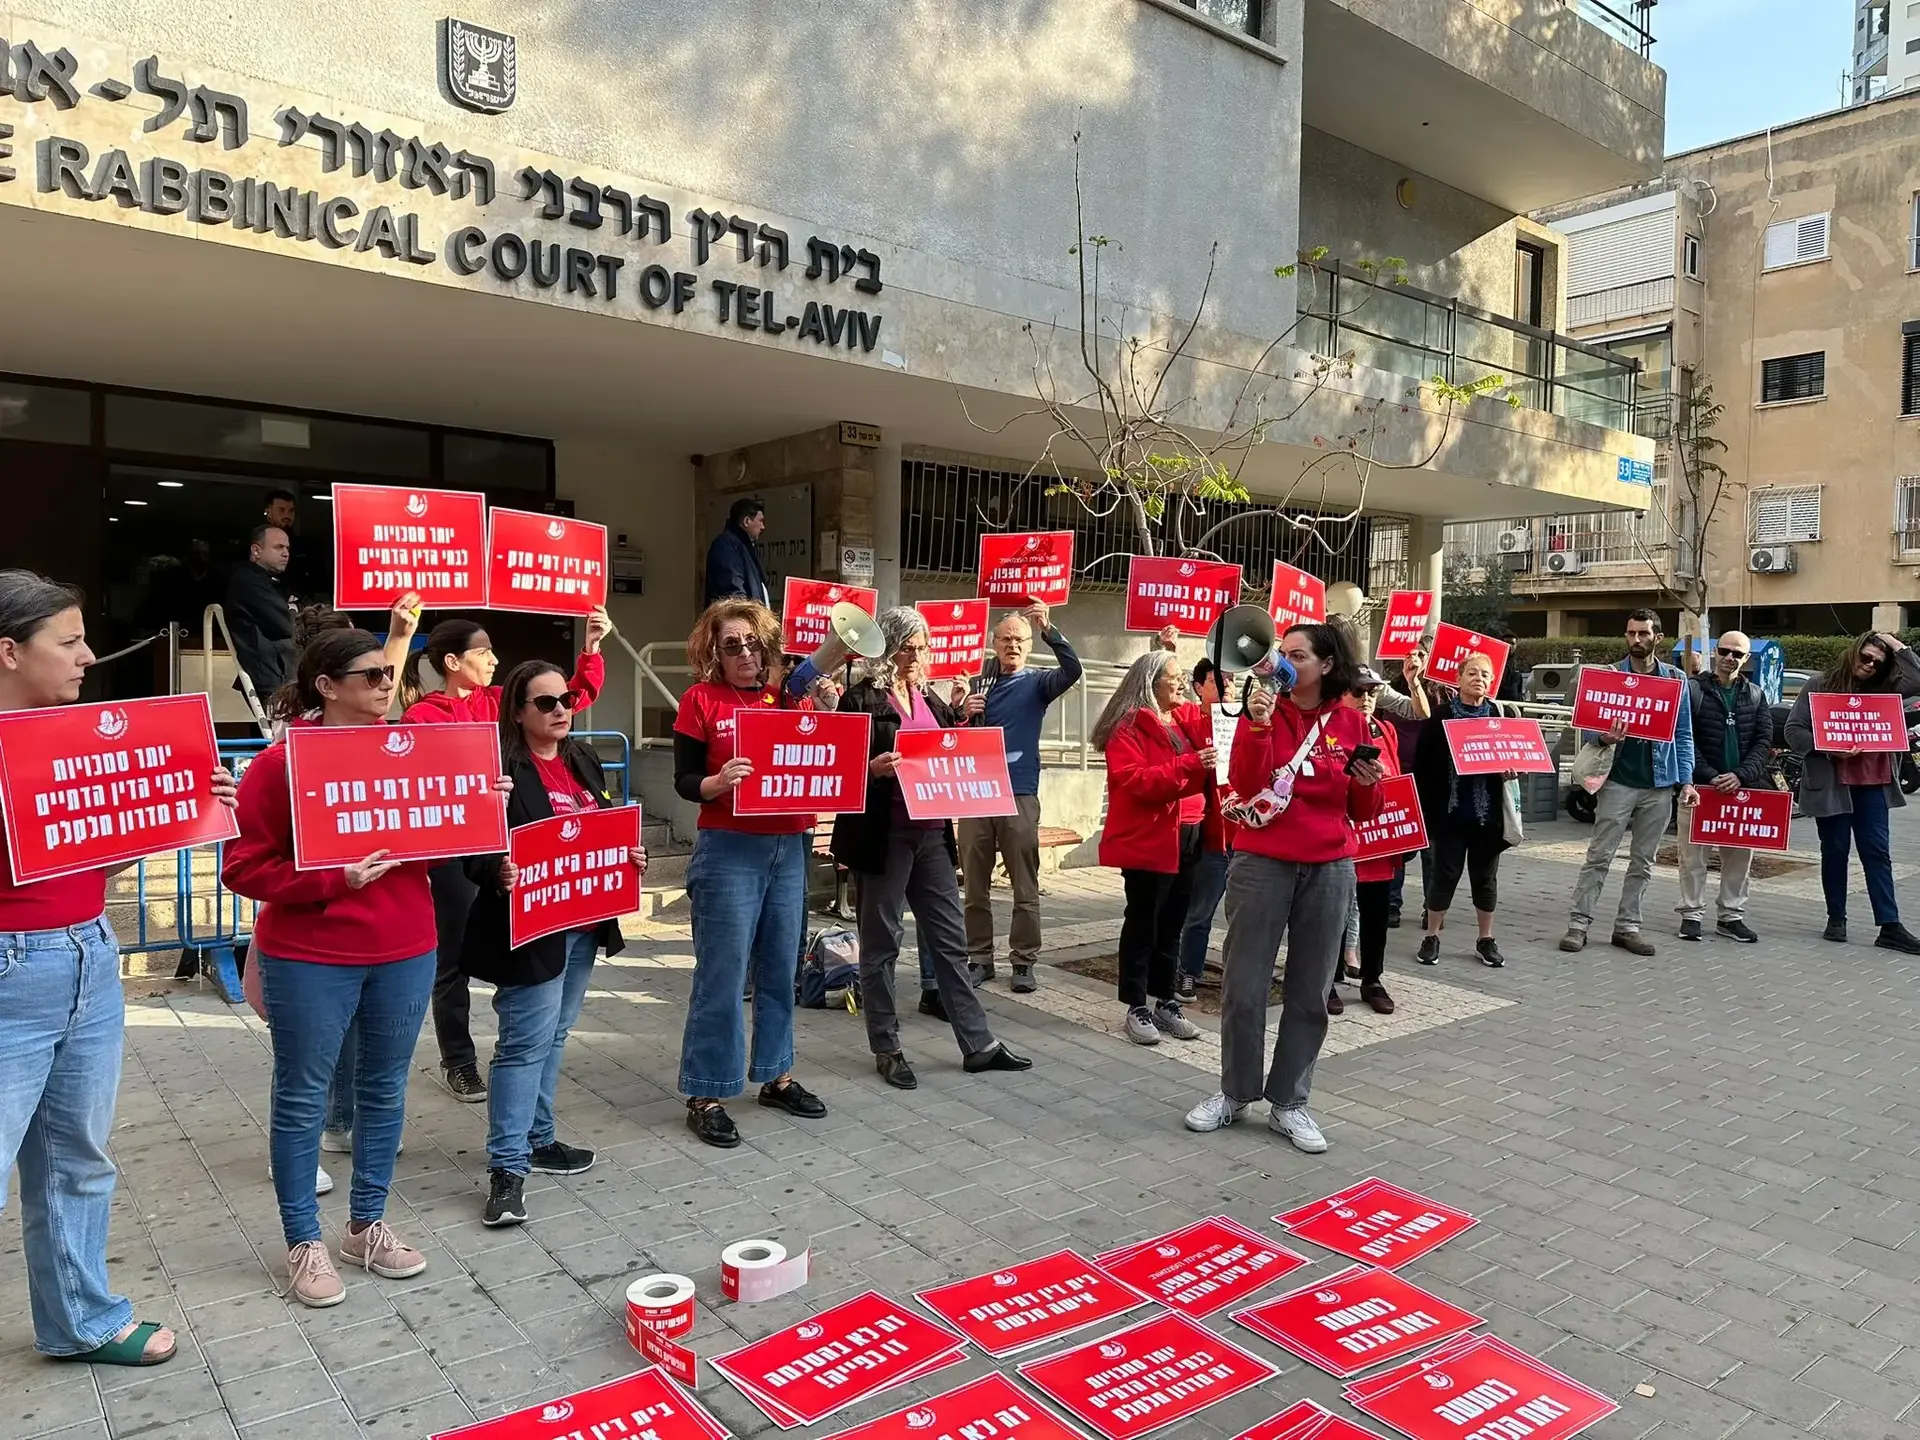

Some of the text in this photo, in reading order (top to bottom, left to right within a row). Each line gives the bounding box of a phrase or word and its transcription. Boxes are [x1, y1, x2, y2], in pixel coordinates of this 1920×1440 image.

[274, 105, 496, 206] האזורי
[514, 165, 672, 245] הרבני
[36, 136, 436, 266] RABBINICAL
[447, 225, 625, 300] COURT
[638, 263, 698, 315] OF
[712, 279, 882, 352] TEL-AVIV
[688, 207, 790, 271] הדין
[804, 235, 883, 295] בית
[1620, 460, 1629, 477] 33
[374, 525, 455, 543] יותר סמכויות
[358, 548, 468, 567] לבתי הדין הדתיים
[507, 551, 601, 578] בית דין דתי חזק
[363, 571, 469, 590] זה מדרון חלקלק
[511, 572, 589, 595] אישה חלשה
[1138, 582, 1230, 604] זה לא בהסכמה
[1199, 606, 1212, 621] זו
[1435, 657, 1459, 672] יינת
[1585, 689, 1670, 713] זה לא בהסכמה
[1829, 711, 1881, 721] יותר סמכויות
[1639, 713, 1652, 726] זו
[1823, 721, 1892, 732] לבתי הדין הדתיים
[1826, 732, 1893, 743] זה מדרון חלקלק
[52, 745, 172, 782] יותר סמכויות
[772, 743, 836, 767] למעשה
[927, 756, 977, 778] אין דין
[35, 769, 195, 817] לבתי הדין הדתיים
[324, 773, 489, 807] בית דין דתי חזק
[761, 774, 843, 798] זאת הלכה
[914, 780, 953, 802] דיינת
[44, 798, 199, 850] זה מדרון חלקלק
[336, 804, 466, 835] אישה חלשה
[1720, 804, 1762, 821] אין דין
[1701, 820, 1779, 839] כשאין דיינת
[519, 845, 628, 888] השנה היא 2024
[523, 870, 623, 913] לא ימי הביניים
[1344, 1209, 1402, 1238] אין דין
[1358, 1212, 1448, 1258] כשאין דיינת
[968, 1273, 1100, 1322] בית דין דתי חזק
[991, 1292, 1100, 1332] אישה חלשה
[1313, 1297, 1397, 1332] למעשה
[1335, 1310, 1441, 1354] זאת הלכה
[762, 1314, 908, 1388] זה לא בהסכמה
[812, 1338, 910, 1389] זו כפייה!
[1084, 1345, 1176, 1389] יותר סמכויות
[1087, 1351, 1214, 1409] לבתי הדין הדתיים
[1111, 1363, 1236, 1423] זה מדרון חלקלק
[630, 1401, 676, 1426] בית
[1432, 1378, 1519, 1426] למעשה
[1513, 1394, 1572, 1427] זאת
[589, 1417, 629, 1440] דין
[957, 1404, 1032, 1440] זה לא
